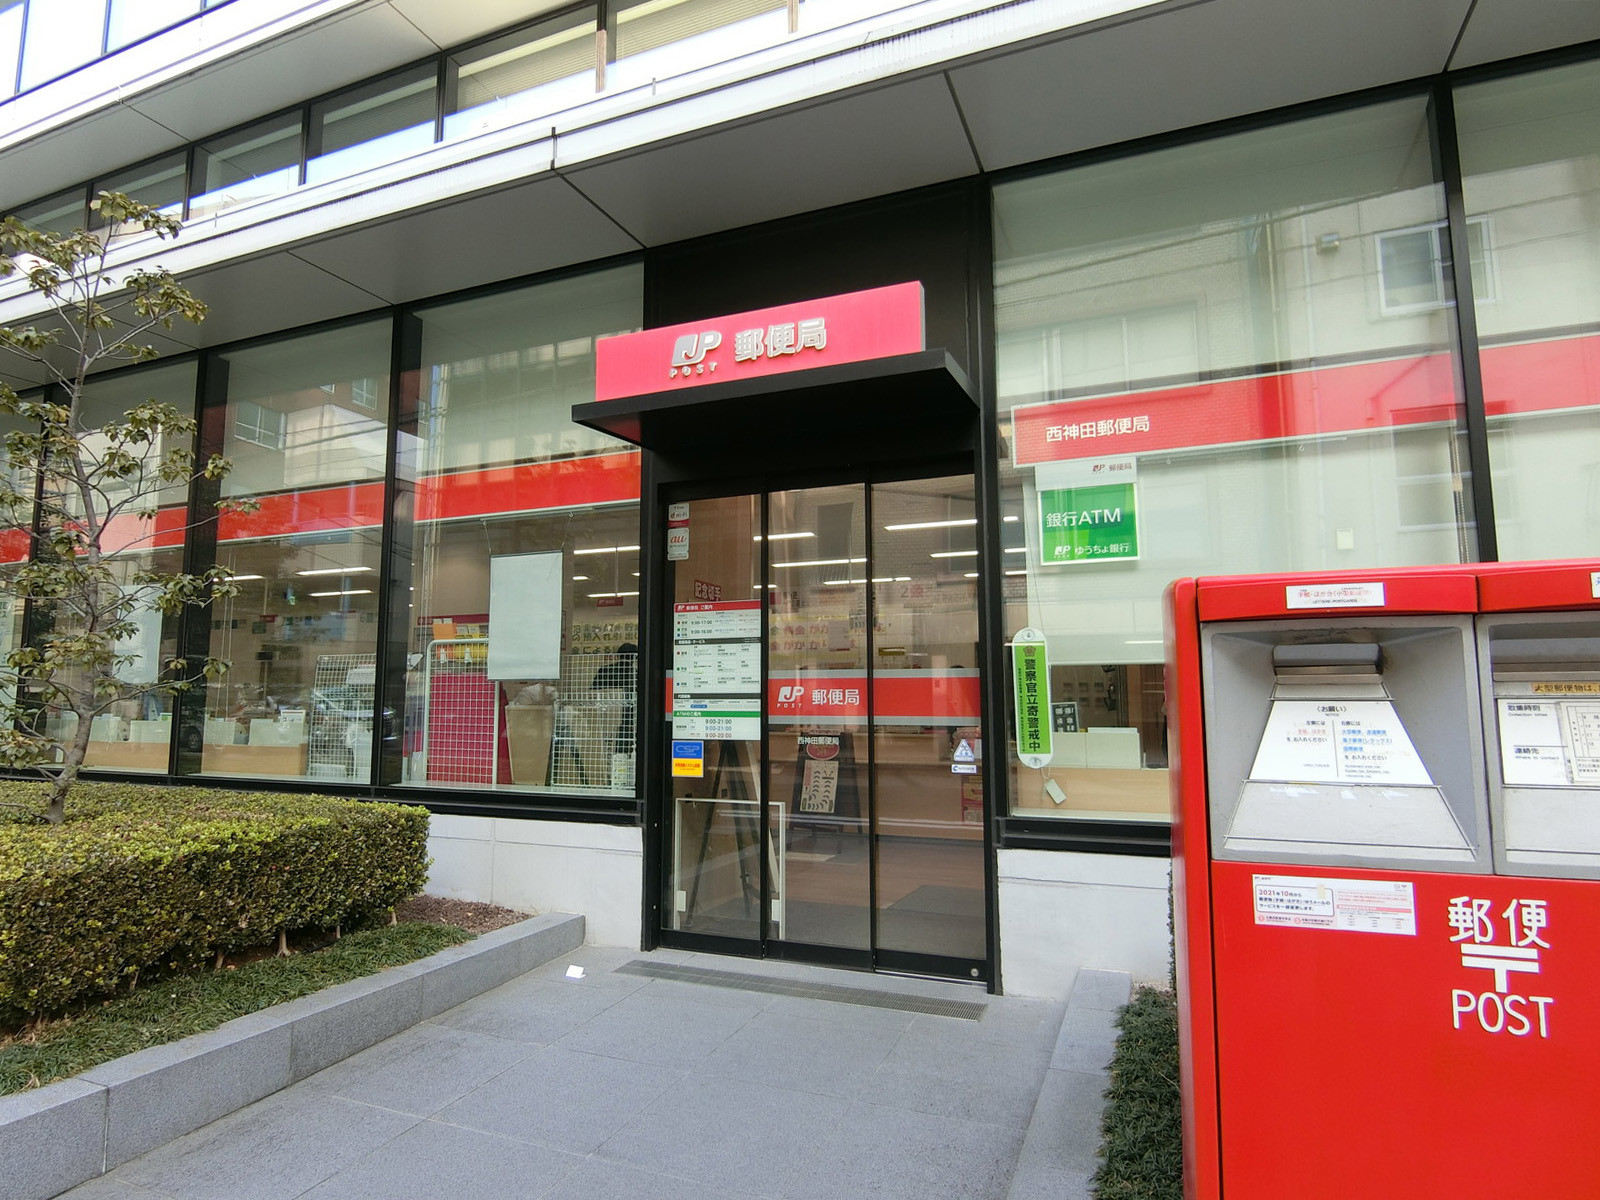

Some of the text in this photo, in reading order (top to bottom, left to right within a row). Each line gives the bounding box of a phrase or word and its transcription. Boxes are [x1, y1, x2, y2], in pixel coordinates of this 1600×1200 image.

[734, 316, 828, 363] 郵便局
[669, 362, 718, 379] POST
[1045, 415, 1150, 443] 西神田郵便局
[1108, 462, 1133, 472] 郵便局
[1046, 508, 1121, 528] 銀行ATM
[670, 535, 687, 544] au
[1075, 543, 1130, 556] ゆうちょ銀行
[1534, 683, 1600, 692] 大型郵便物は、
[811, 688, 860, 706] 郵便局
[1024, 658, 1041, 752] 警察官立寄警戒中
[675, 745, 700, 754] CSP
[797, 736, 840, 746] 西神田郵便局
[1448, 896, 1550, 949] 郵便
[1452, 988, 1554, 1038] POST
